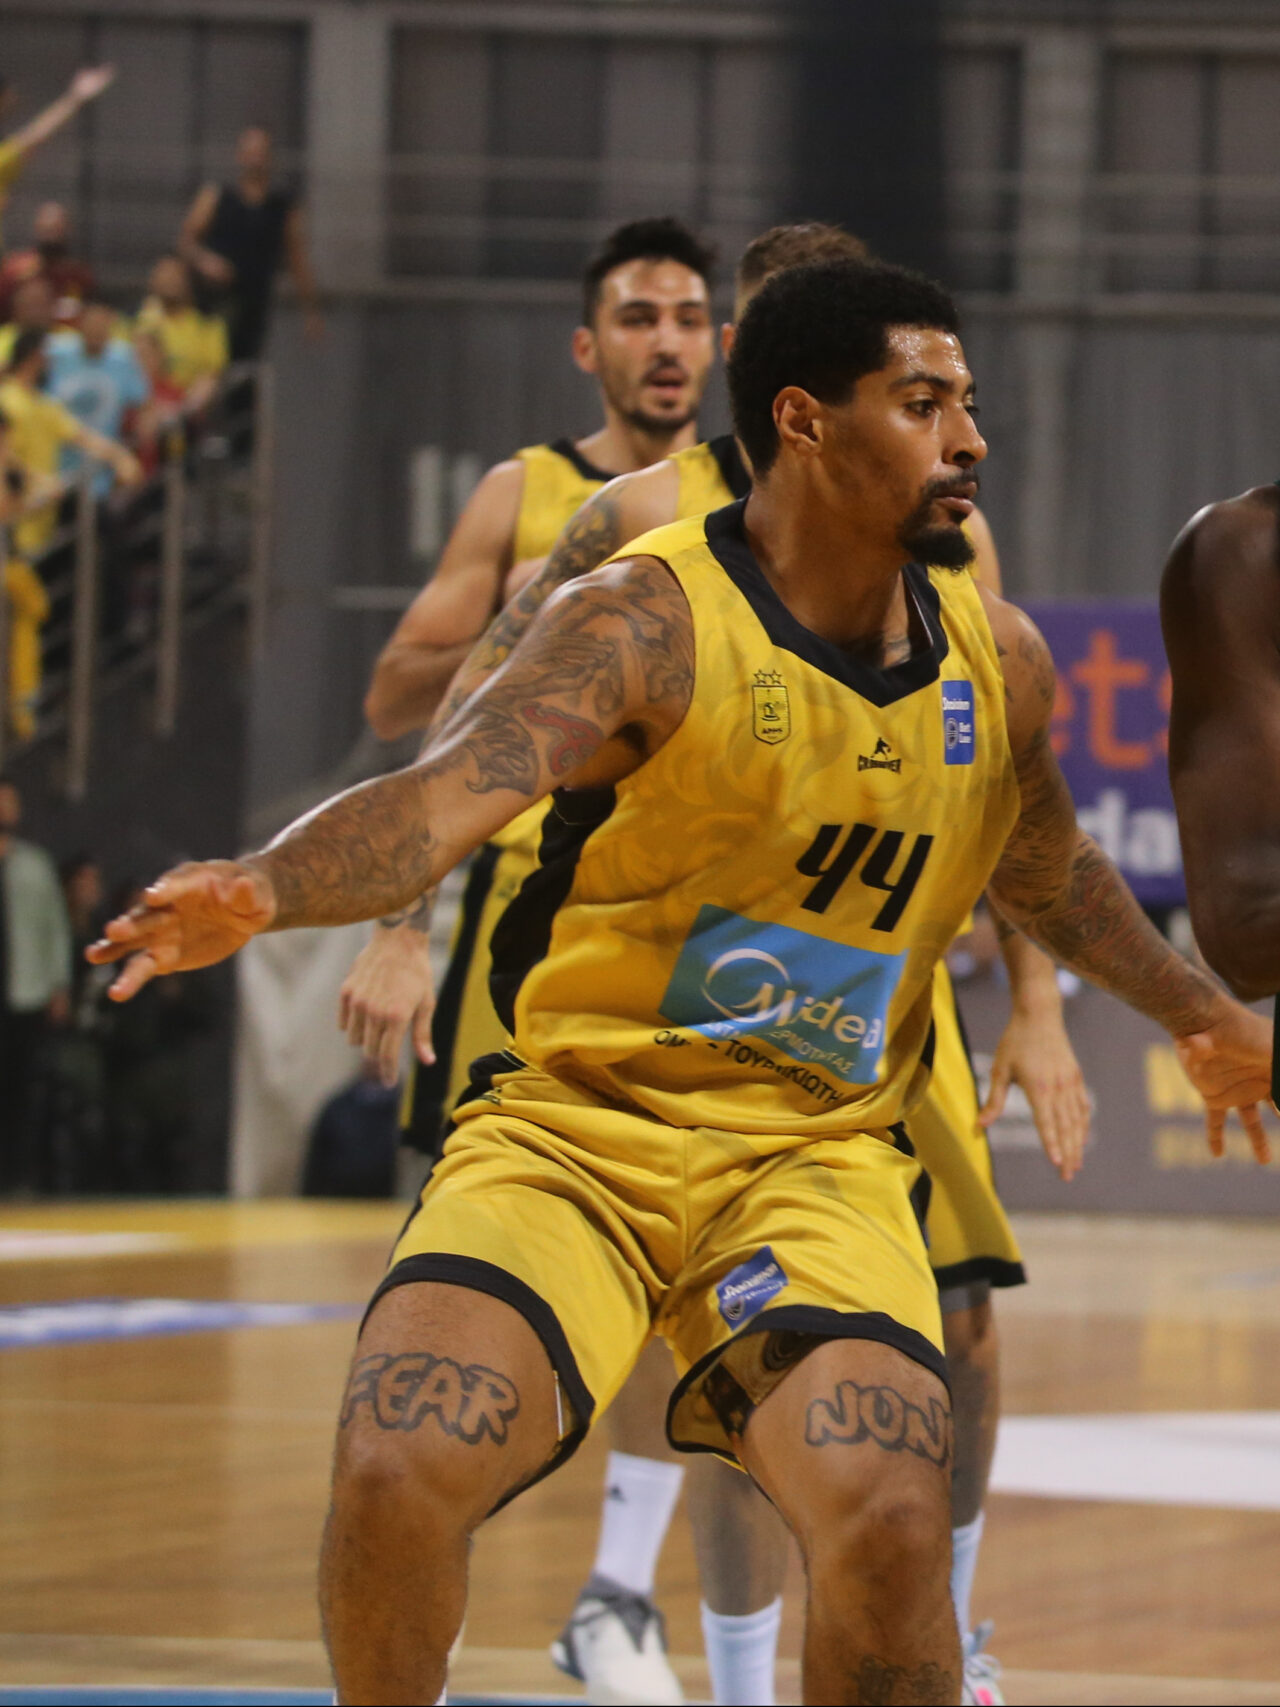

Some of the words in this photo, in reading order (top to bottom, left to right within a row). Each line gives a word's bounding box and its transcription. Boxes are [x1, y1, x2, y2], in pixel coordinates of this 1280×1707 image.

[795, 822, 935, 934] 44
[712, 962, 882, 1049] Midea
[339, 1352, 520, 1445] FEAR
